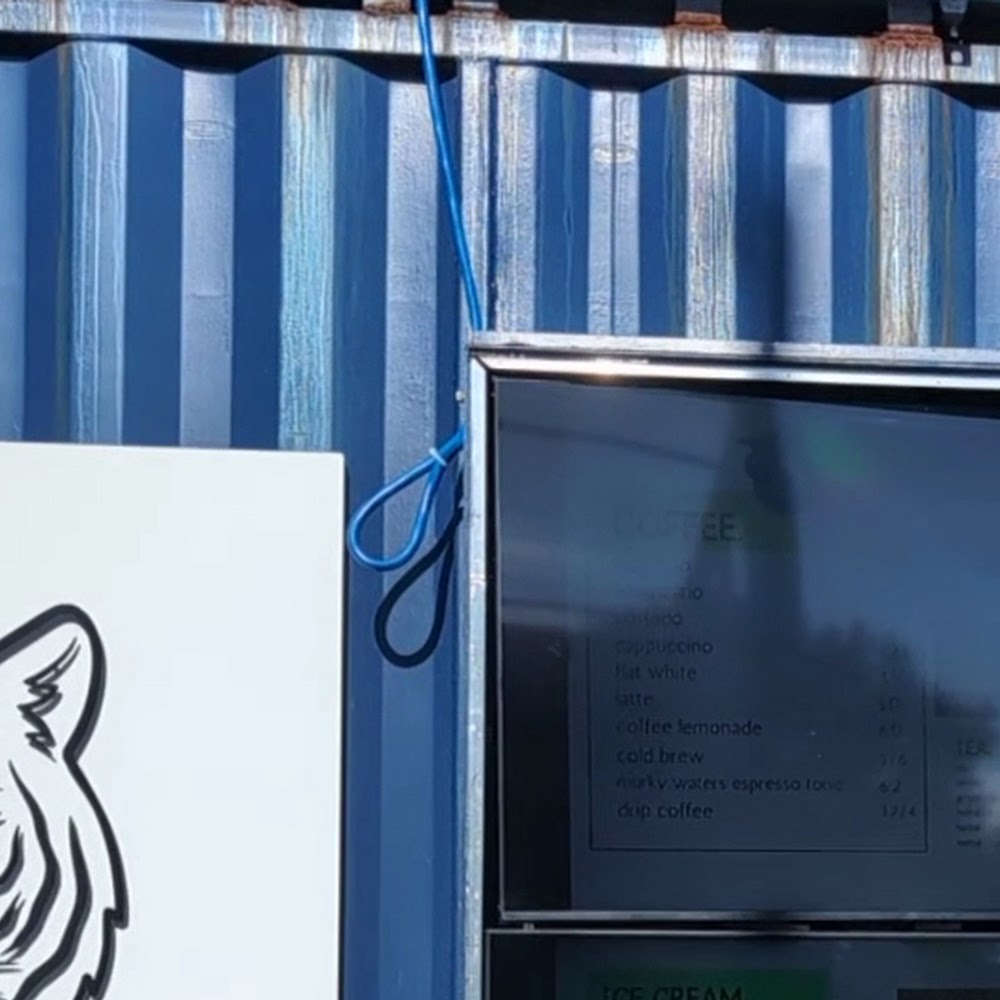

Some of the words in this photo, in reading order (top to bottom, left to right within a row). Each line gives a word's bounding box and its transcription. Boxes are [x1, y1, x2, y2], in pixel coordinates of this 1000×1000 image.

[677, 717, 763, 737] lemonade
[616, 748, 651, 764] cold
[658, 748, 704, 764] brew
[731, 776, 801, 795] espresso
[656, 801, 714, 819] coffee
